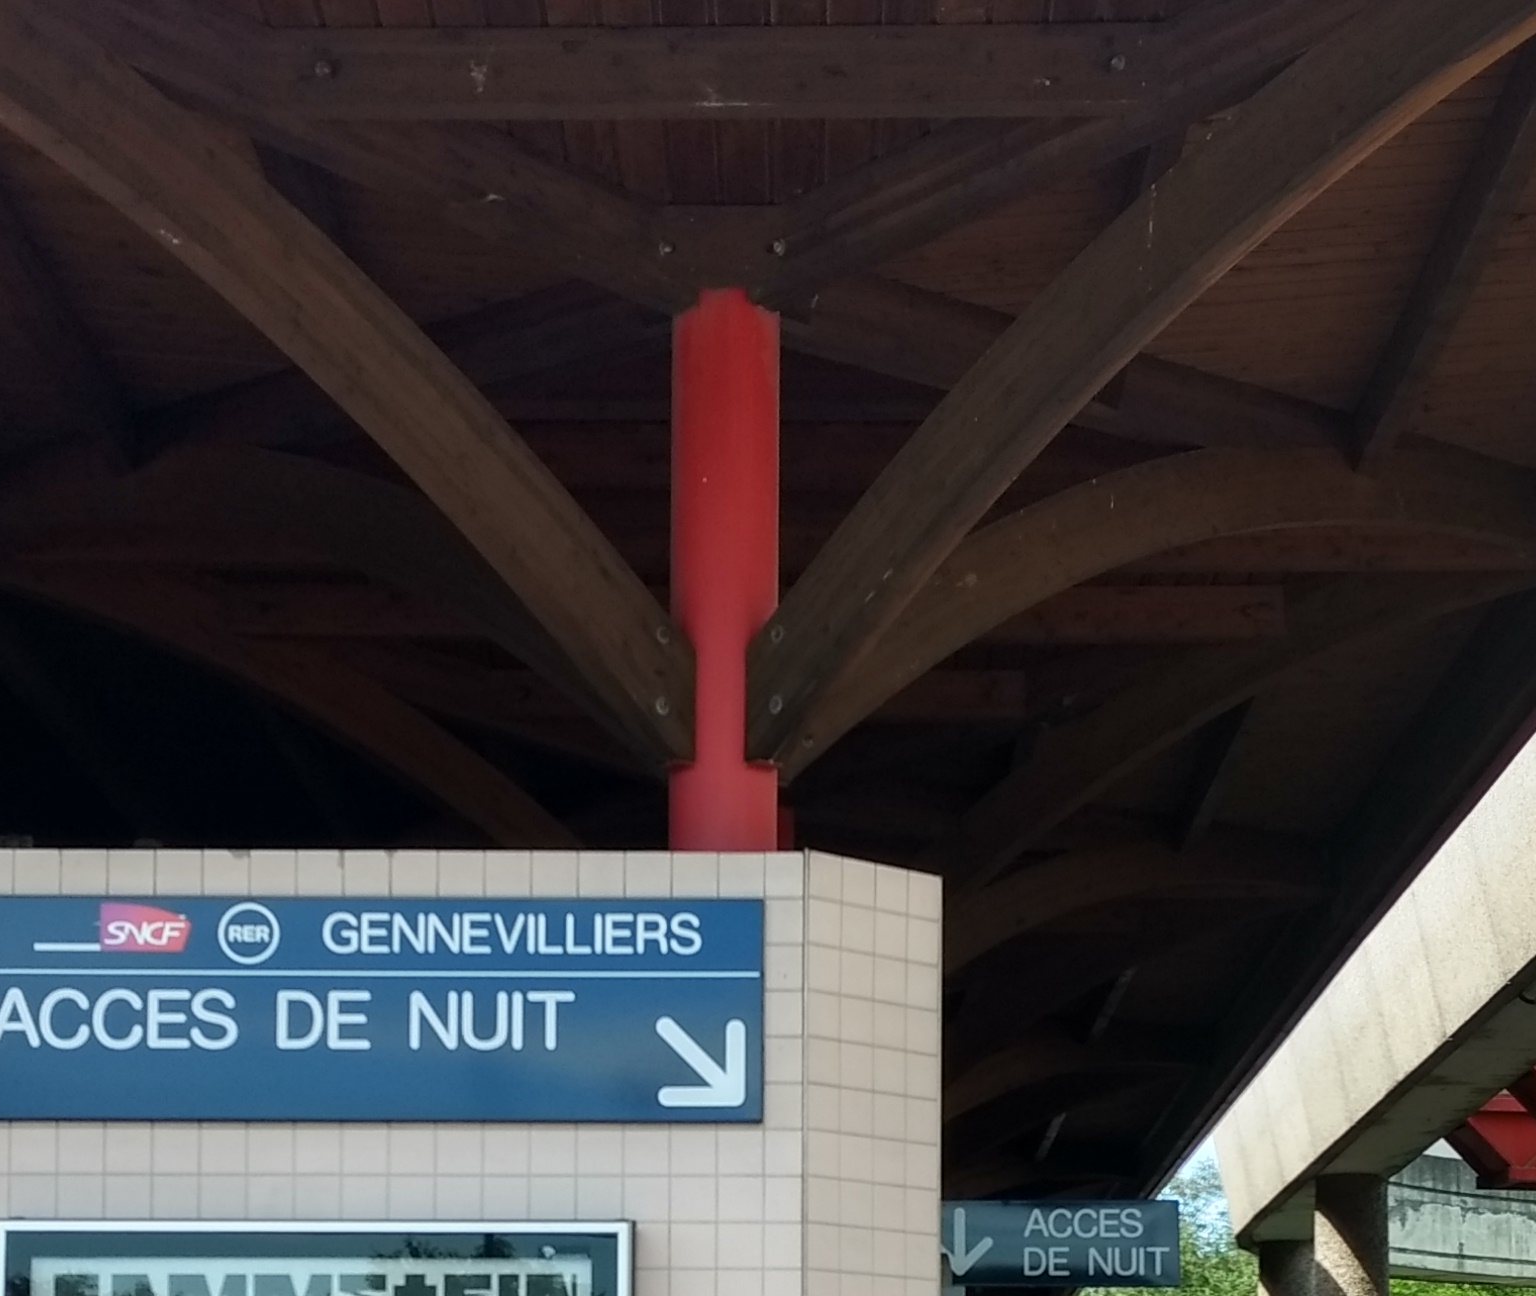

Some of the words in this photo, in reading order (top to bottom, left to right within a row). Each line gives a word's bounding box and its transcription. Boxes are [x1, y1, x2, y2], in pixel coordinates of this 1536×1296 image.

[104, 920, 186, 946] SNCF
[227, 924, 271, 943] RER
[321, 911, 703, 956] GENNEVILLIERS
[275, 989, 371, 1051] DE
[409, 990, 576, 1051] NUIT
[1024, 1208, 1144, 1239] ACCES
[1024, 1247, 1070, 1277] DE
[1088, 1247, 1170, 1277] NUIT
